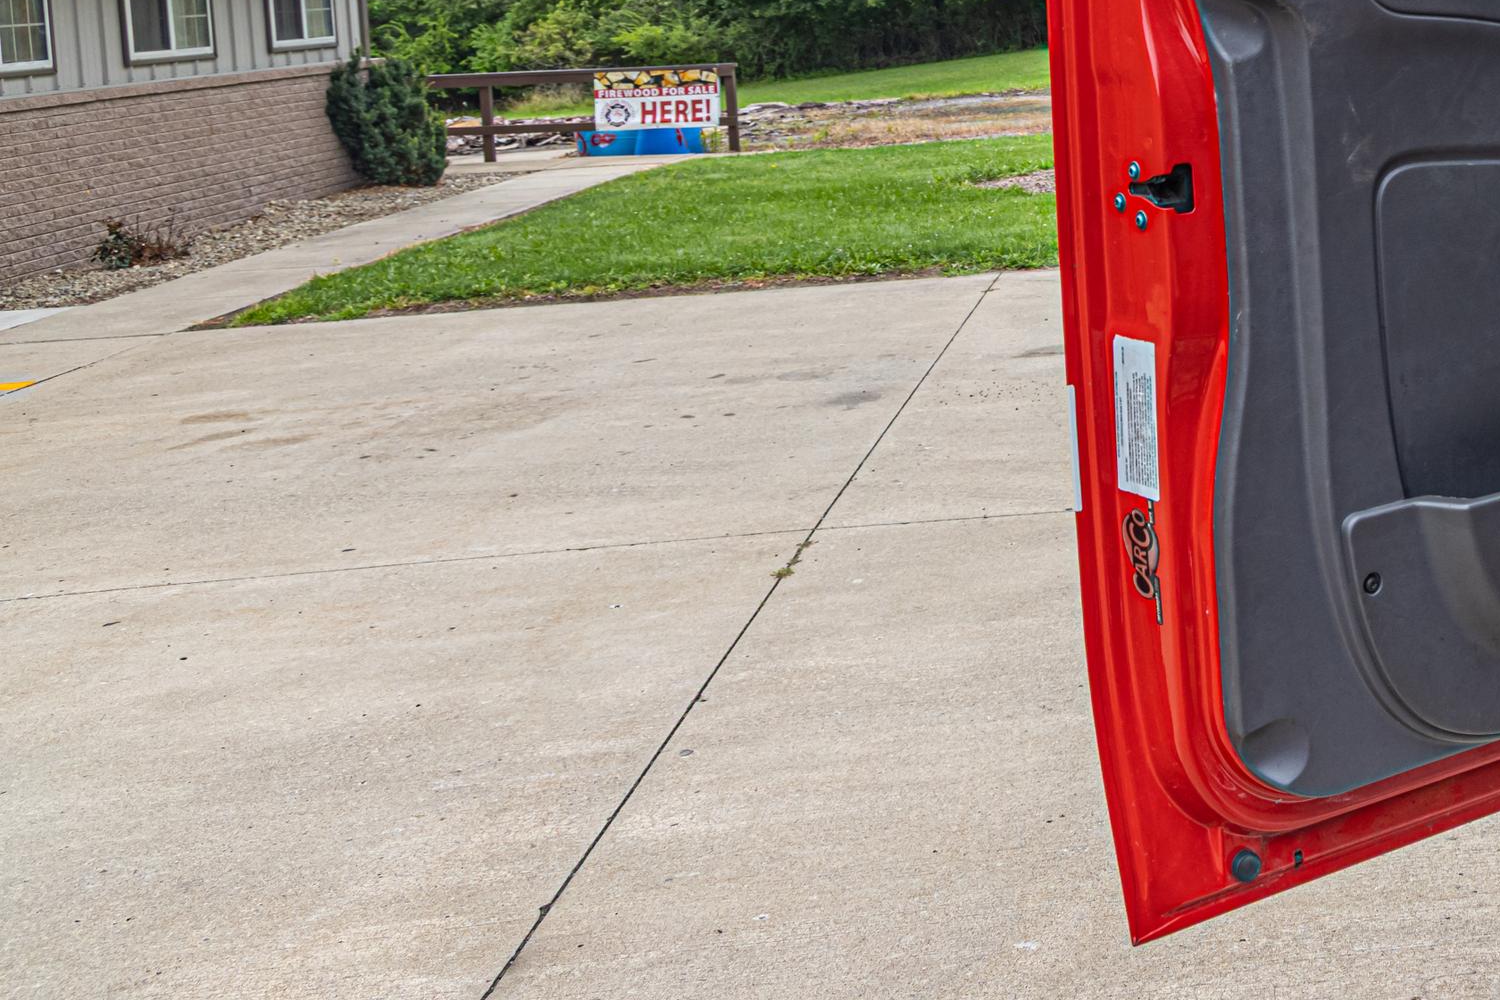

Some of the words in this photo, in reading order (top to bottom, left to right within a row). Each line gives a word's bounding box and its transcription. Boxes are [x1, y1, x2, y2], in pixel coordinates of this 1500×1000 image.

[598, 89, 659, 98] FIREWOOD
[662, 87, 685, 96] FOR
[687, 85, 716, 95] SALE
[640, 99, 711, 124] HERE!
